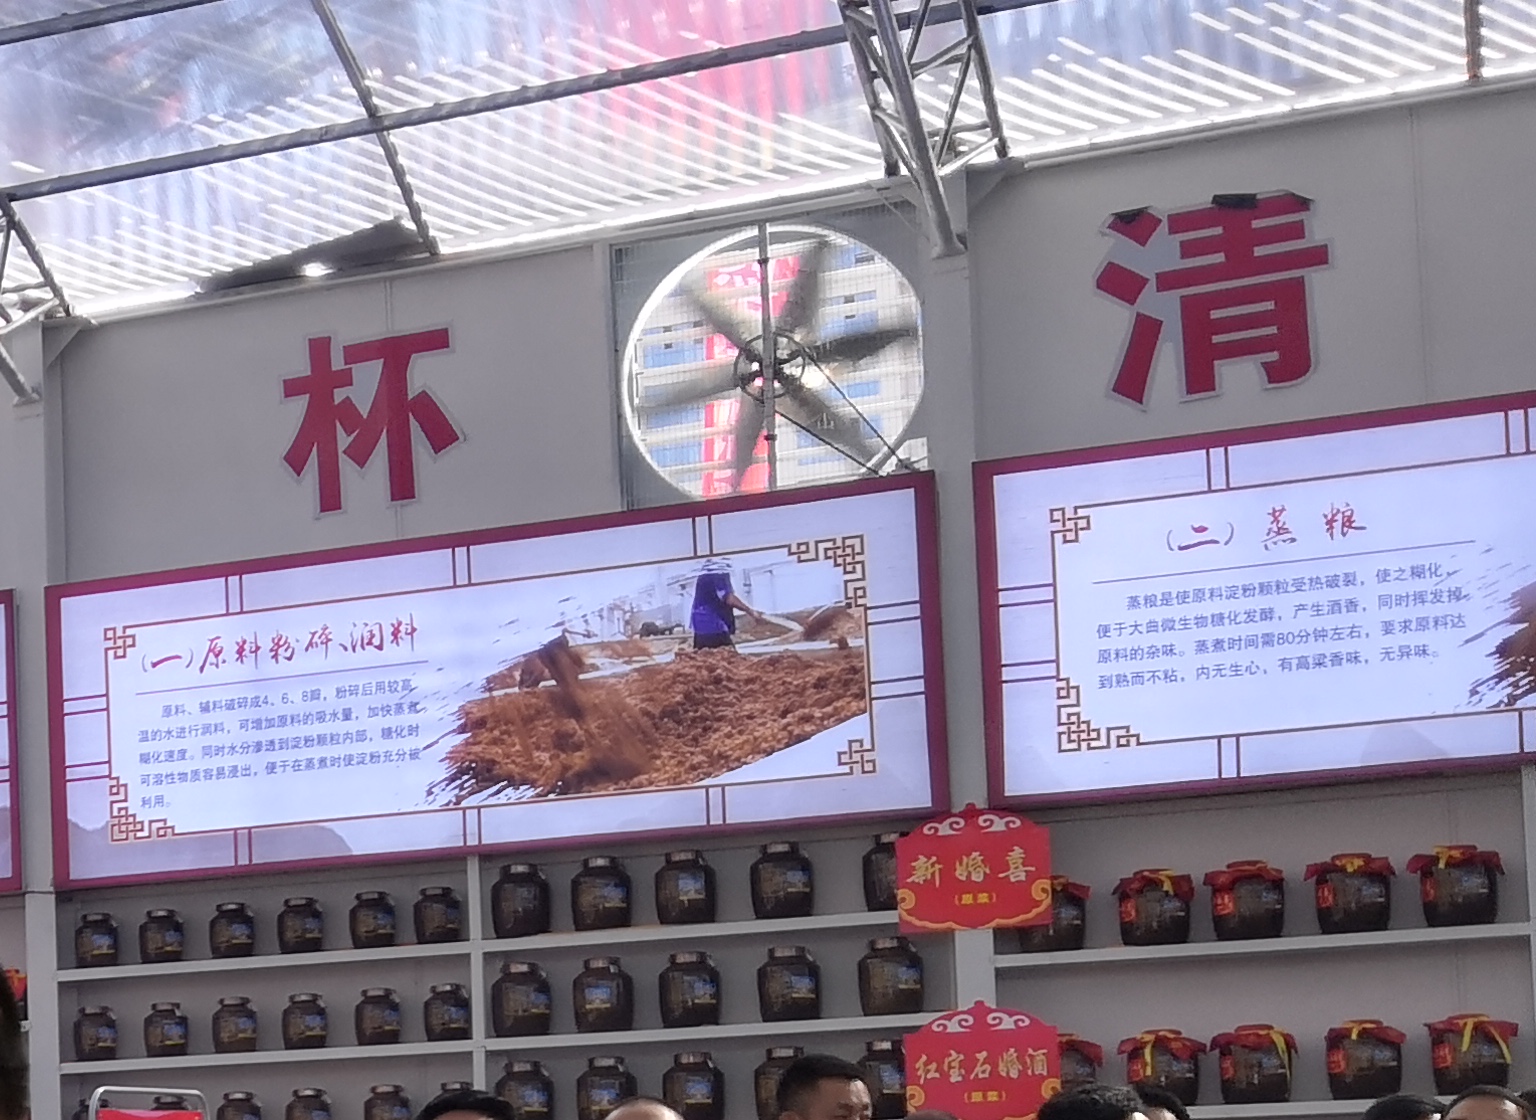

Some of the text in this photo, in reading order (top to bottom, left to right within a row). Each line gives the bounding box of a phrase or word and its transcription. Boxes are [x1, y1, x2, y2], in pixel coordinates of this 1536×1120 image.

[1096, 192, 1330, 402] 清
[281, 328, 464, 510] 杯
[906, 846, 1037, 888] 新婚喜
[916, 1047, 1049, 1086] 红宝石婚酒
